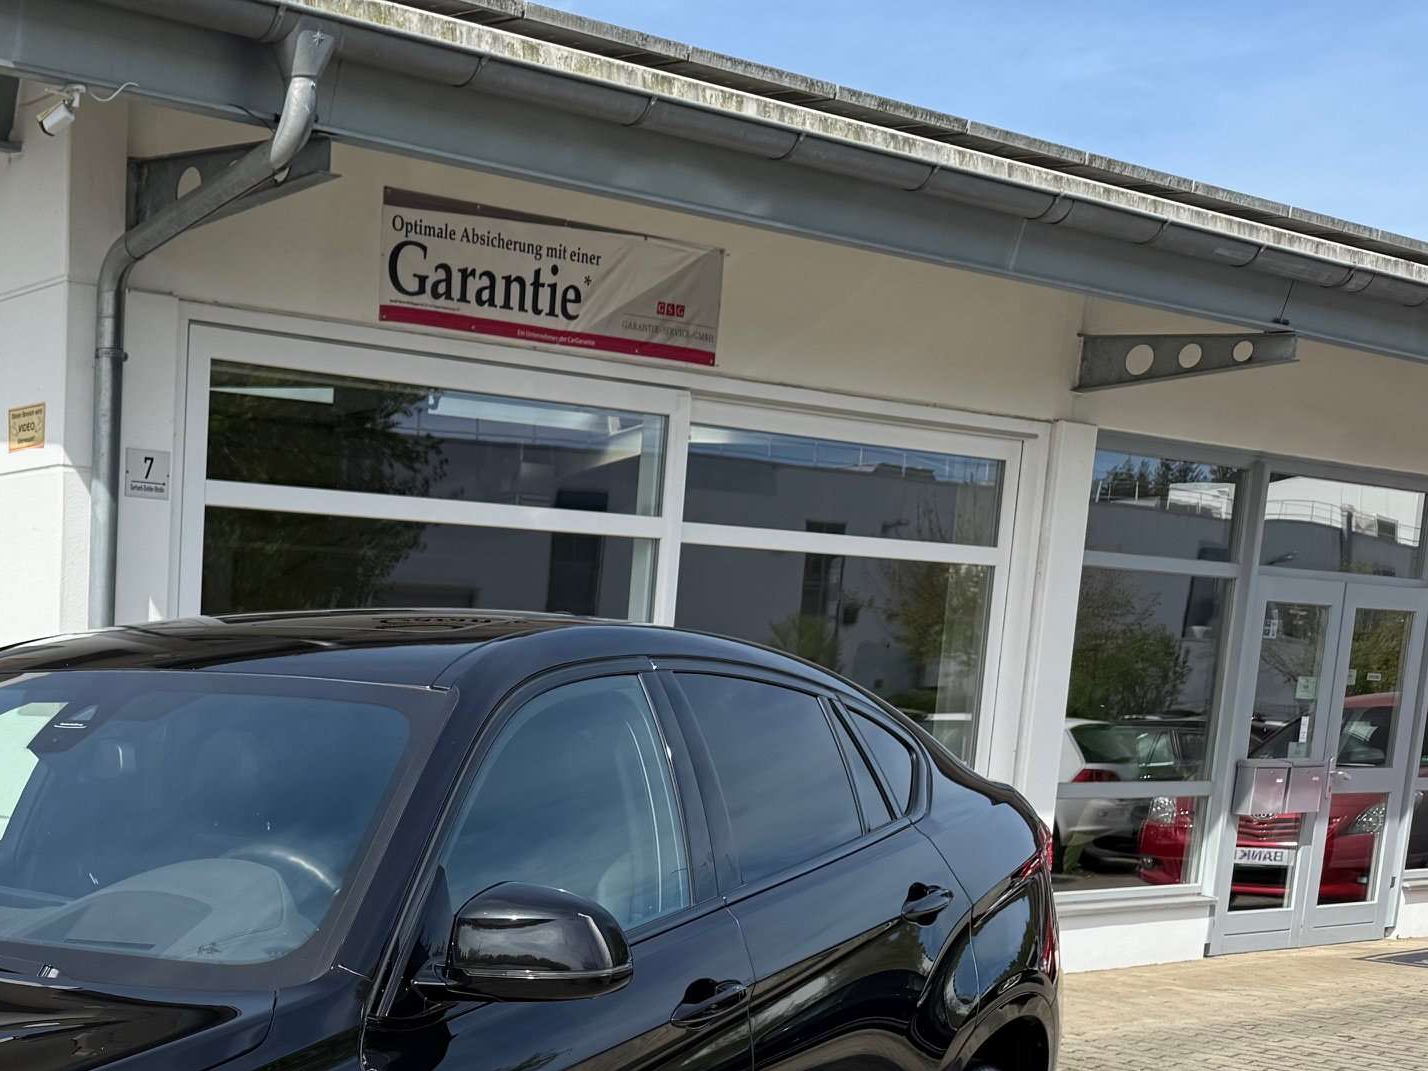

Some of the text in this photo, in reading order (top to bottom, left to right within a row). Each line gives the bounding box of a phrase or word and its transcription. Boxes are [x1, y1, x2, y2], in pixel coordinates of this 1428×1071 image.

[392, 215, 602, 266] Optimale Absicherung mit einer
[657, 302, 685, 317] GSG
[144, 456, 154, 479] 7
